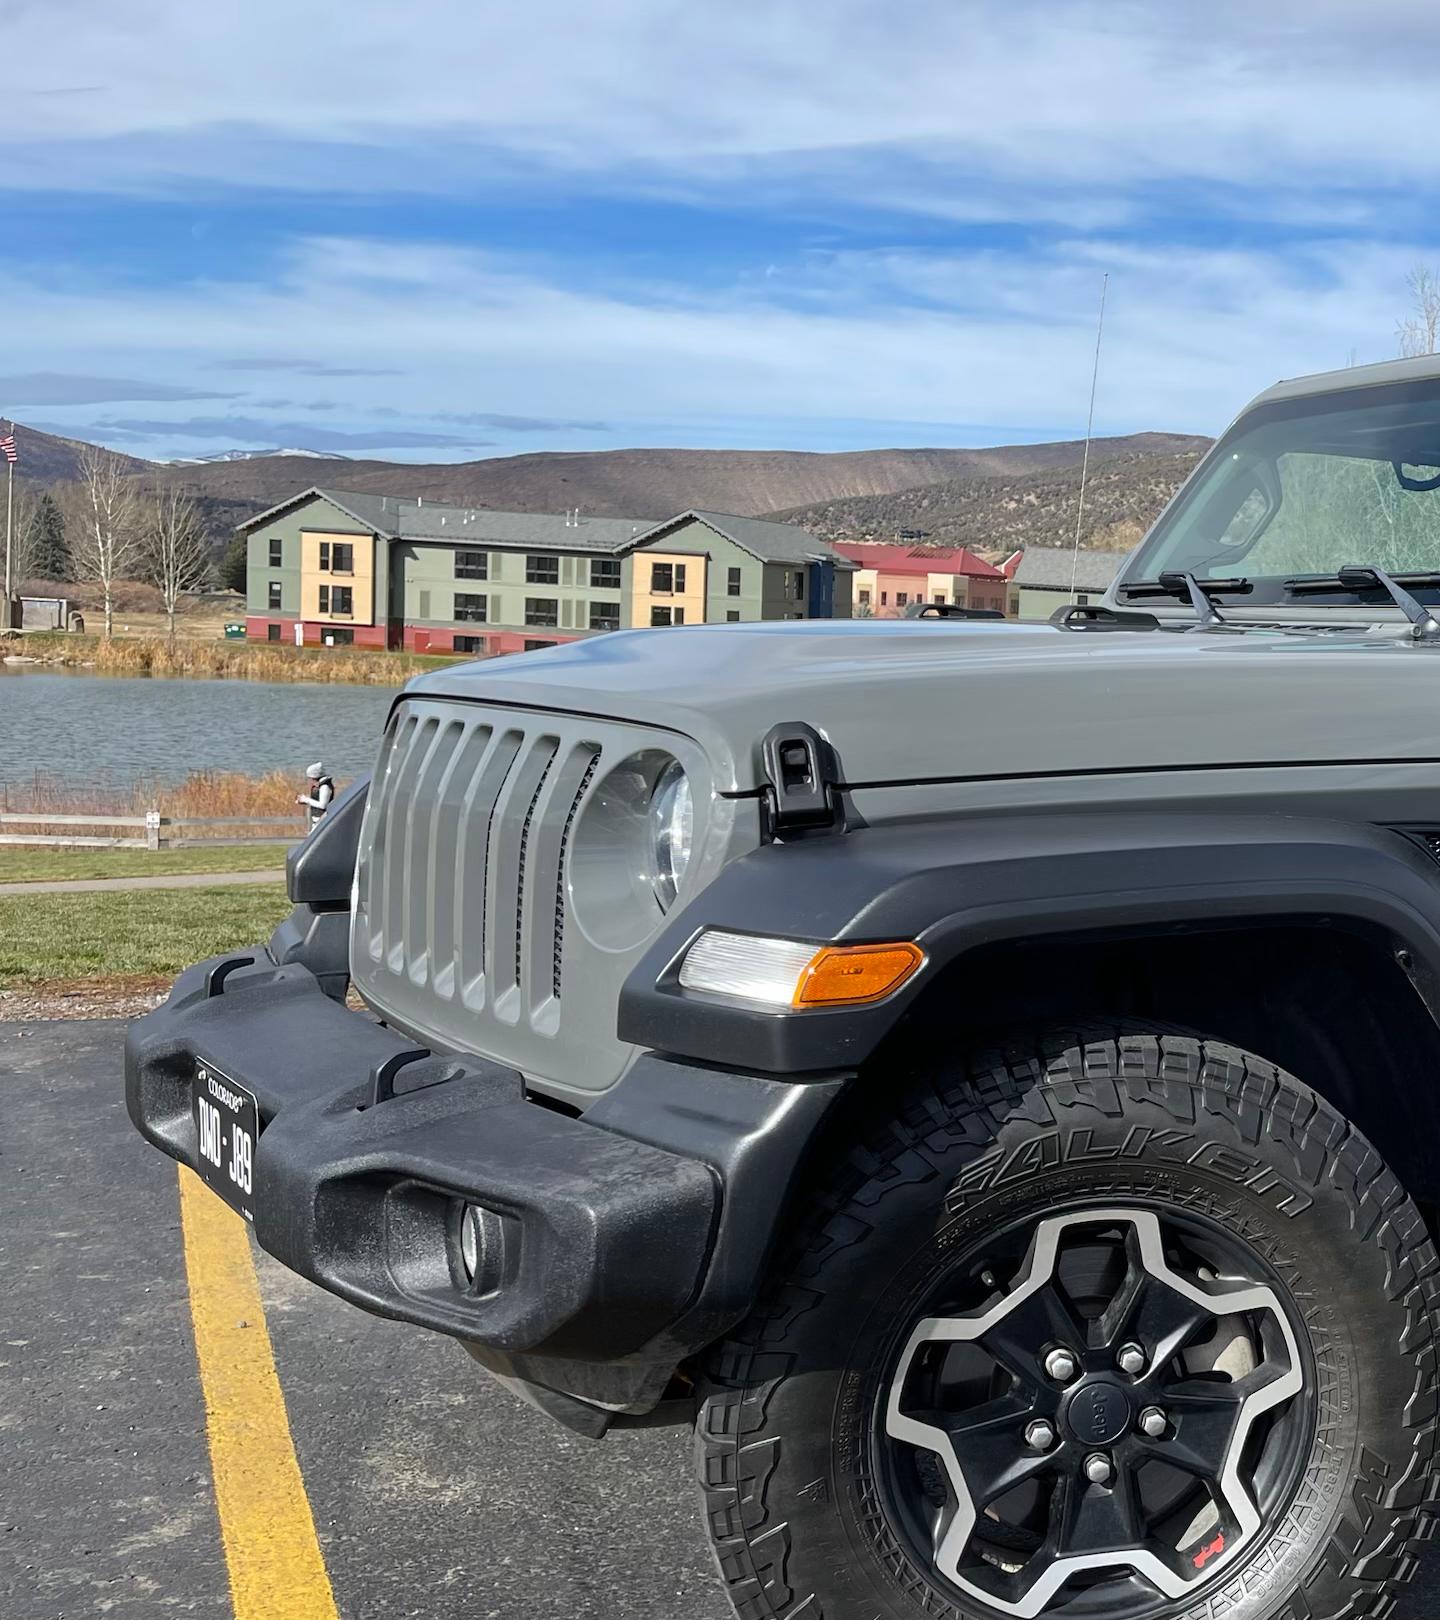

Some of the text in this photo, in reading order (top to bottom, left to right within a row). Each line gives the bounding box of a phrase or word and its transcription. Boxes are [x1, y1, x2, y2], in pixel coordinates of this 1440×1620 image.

[208, 1077, 243, 1113] COLORADO
[943, 1122, 1315, 1218] FALKEN
[1090, 1391, 1108, 1434] Jeep
